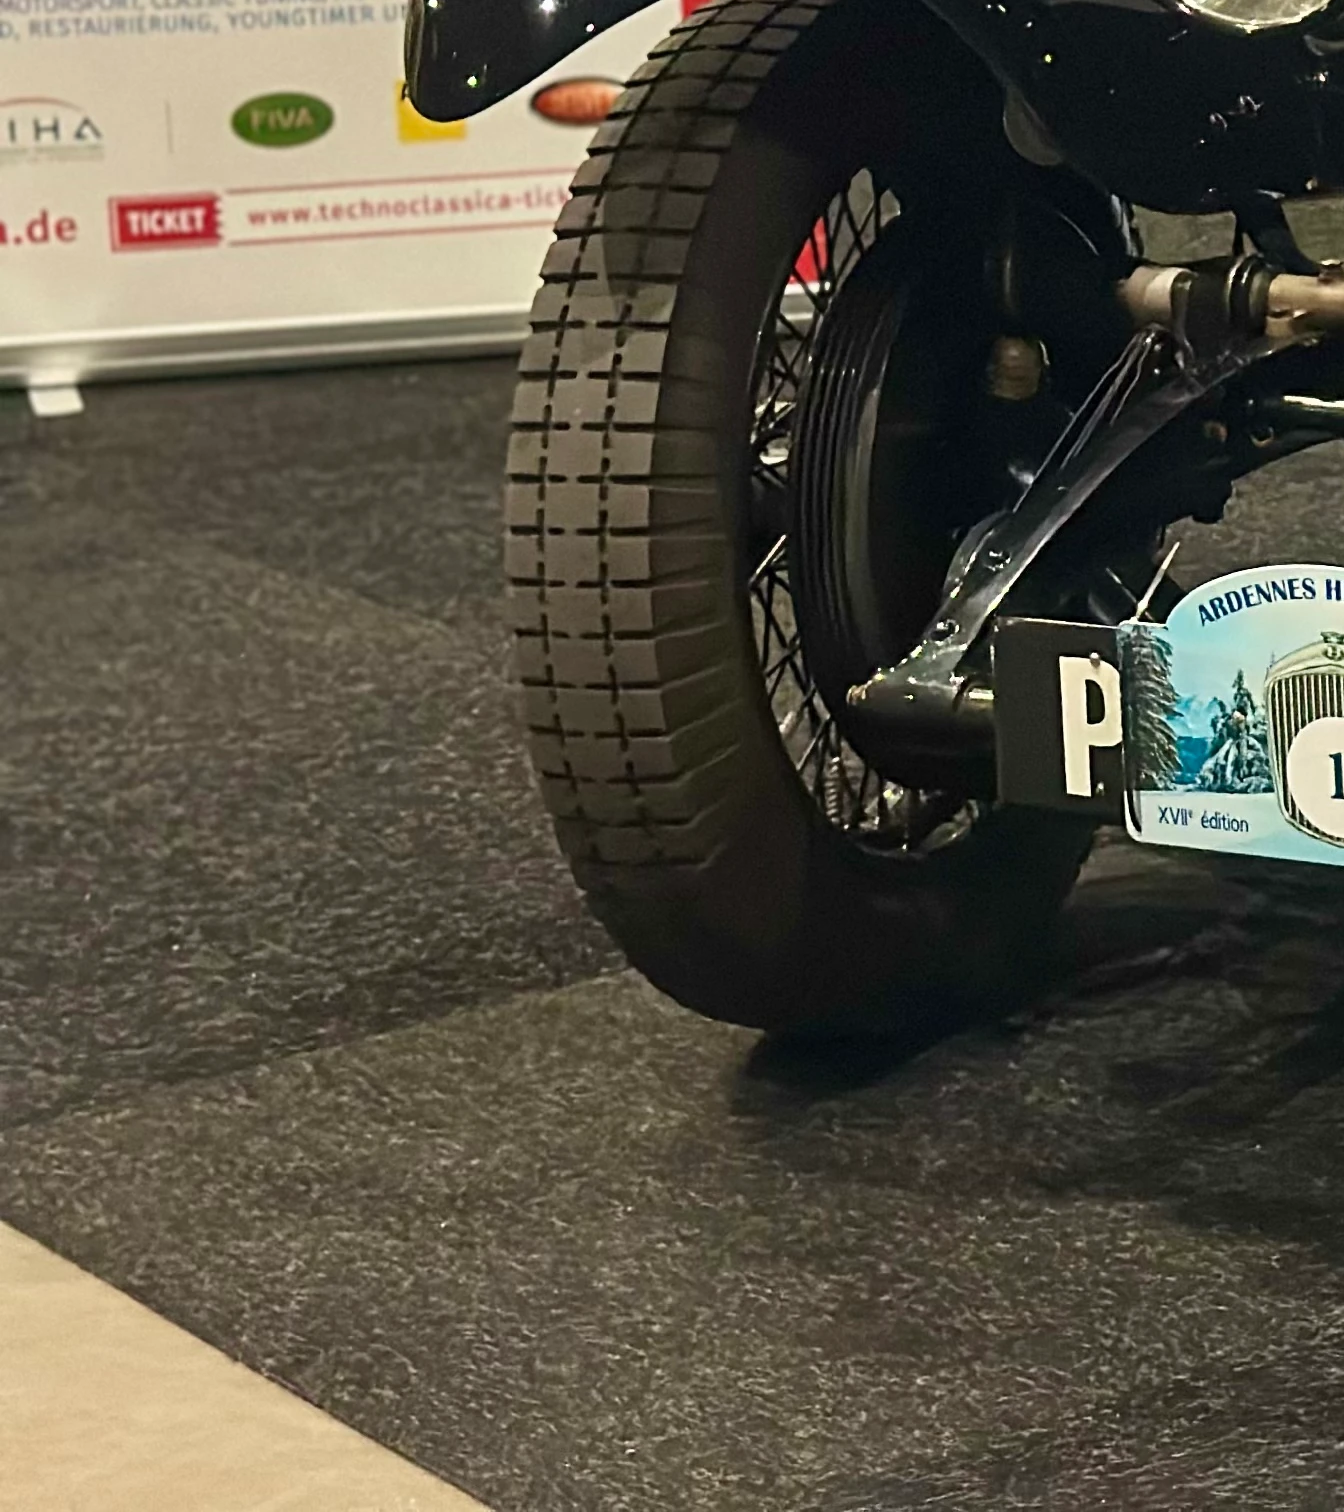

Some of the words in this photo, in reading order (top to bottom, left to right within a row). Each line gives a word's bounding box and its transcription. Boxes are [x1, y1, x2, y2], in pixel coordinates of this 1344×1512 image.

[228, 4, 375, 30] YOUNGTIMER
[126, 206, 207, 238] TICKET
[1197, 577, 1317, 627] ARDENNES
[1200, 809, 1250, 834] édition
